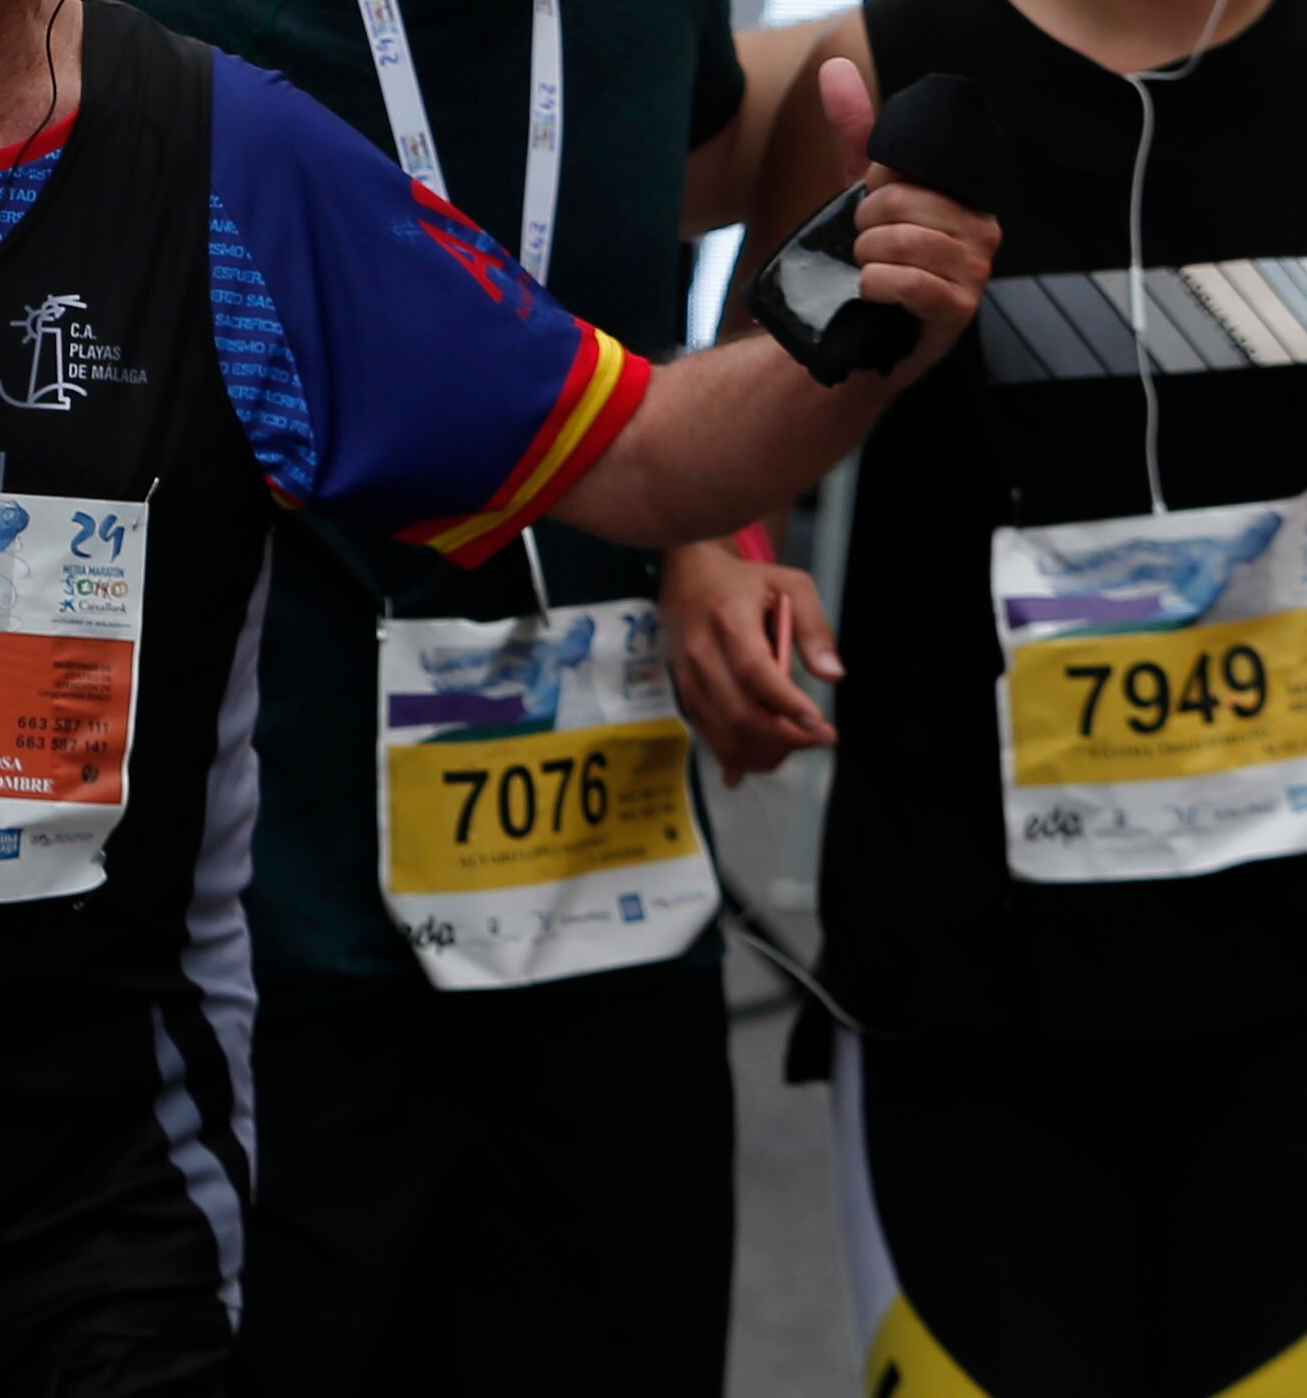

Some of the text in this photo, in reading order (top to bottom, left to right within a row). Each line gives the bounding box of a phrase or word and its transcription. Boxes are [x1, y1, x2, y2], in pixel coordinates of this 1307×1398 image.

[69, 322, 97, 340] C.A.
[69, 342, 122, 362] PLAYAS
[68, 363, 149, 384] DE MÁLAGA
[70, 510, 126, 562] 29
[1066, 643, 1269, 739] 7949
[17, 716, 108, 734] 663 587 111
[15, 734, 45, 749] 663
[86, 740, 107, 754] 141
[442, 750, 608, 845] 7076
